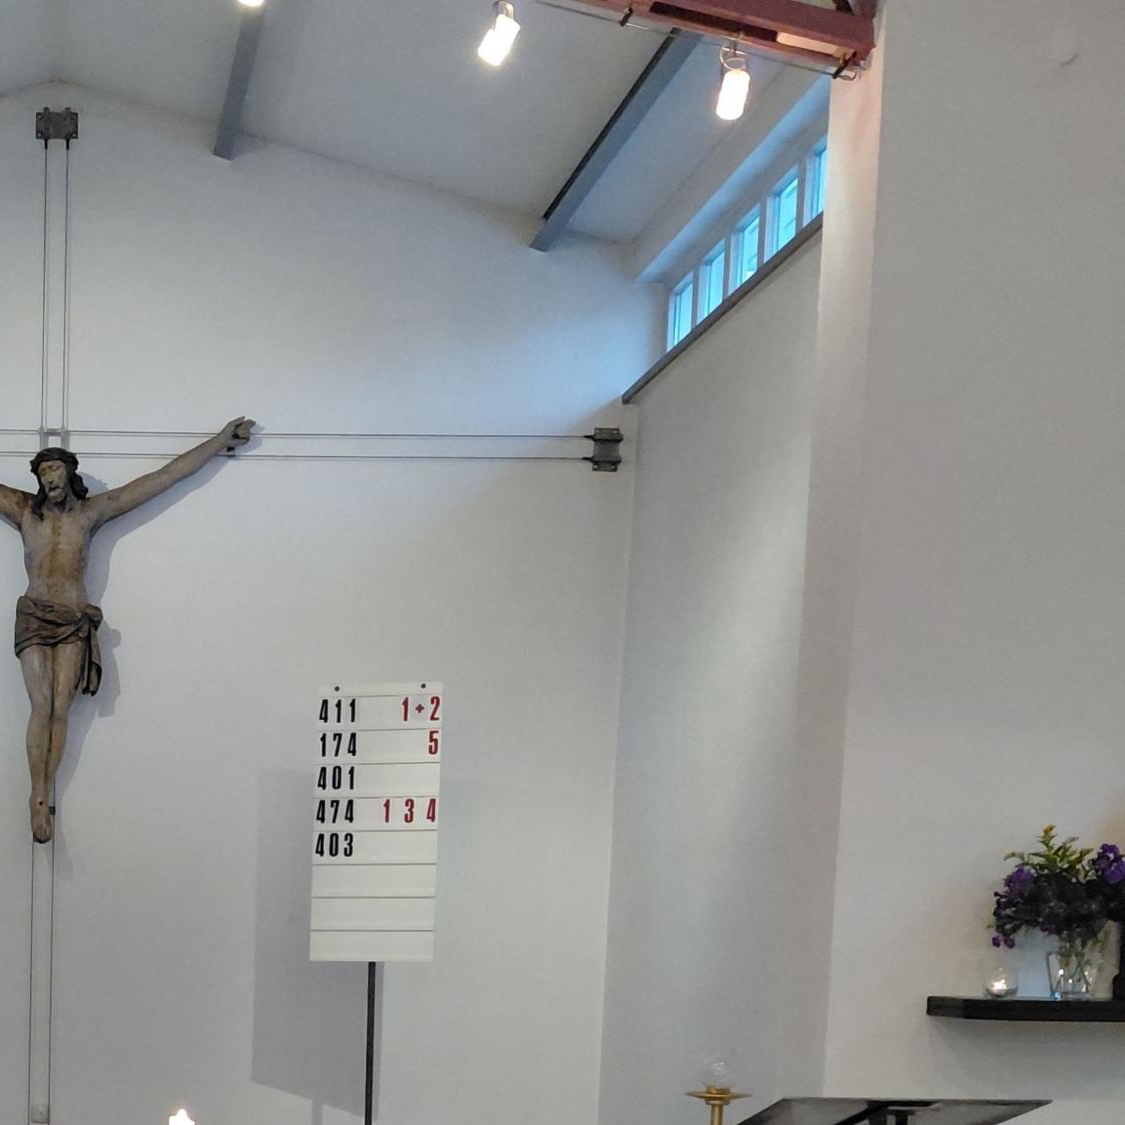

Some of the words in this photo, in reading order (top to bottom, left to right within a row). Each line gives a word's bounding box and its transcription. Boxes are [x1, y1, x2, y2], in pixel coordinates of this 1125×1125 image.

[319, 698, 357, 723] 411
[319, 732, 357, 757] 174
[428, 730, 440, 755] 5
[317, 766, 355, 790] 401
[316, 799, 355, 824] 474
[315, 832, 354, 857] 403
